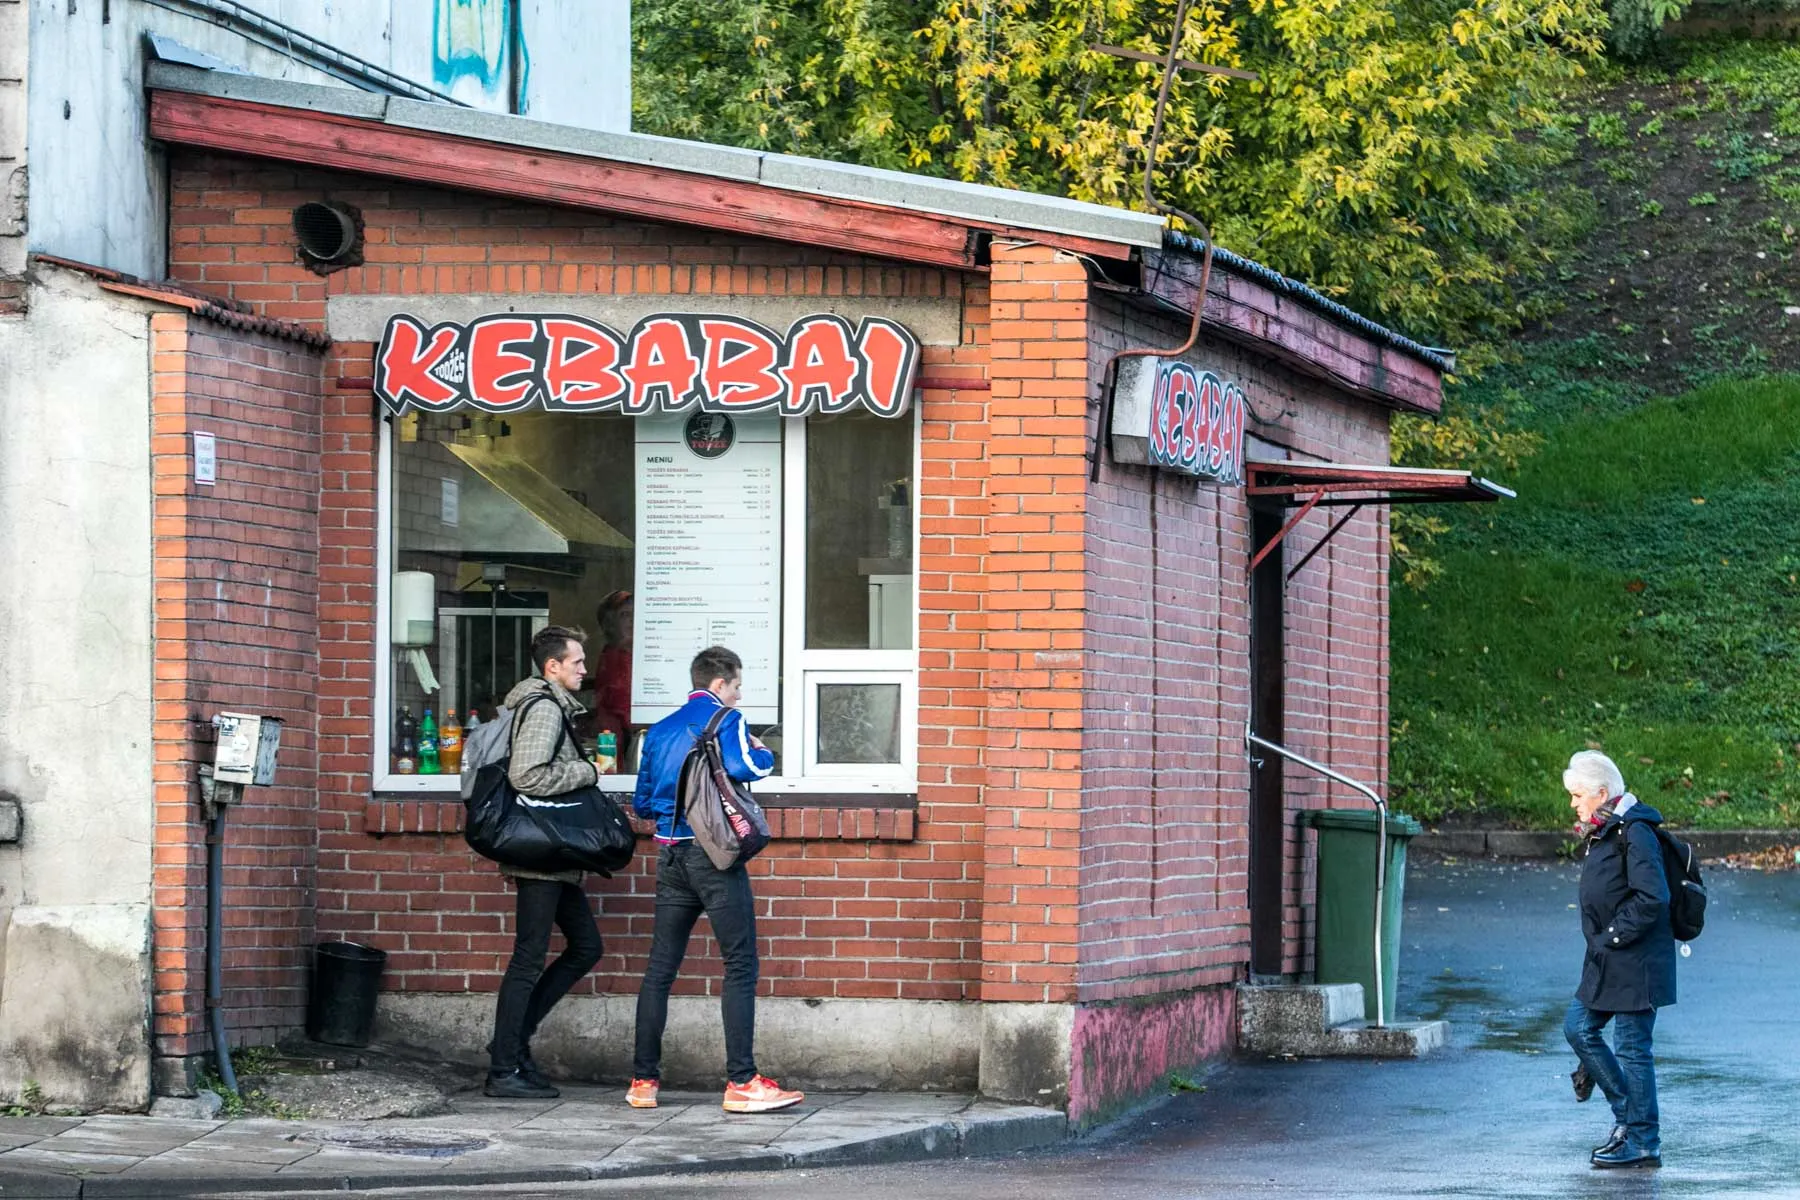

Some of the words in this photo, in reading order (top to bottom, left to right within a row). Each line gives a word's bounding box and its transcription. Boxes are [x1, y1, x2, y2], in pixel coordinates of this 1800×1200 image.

[380, 316, 910, 410] KEBABAI
[1150, 364, 1245, 485] KEBABAI
[646, 456, 673, 464] MENIU
[729, 815, 752, 837] AIR
